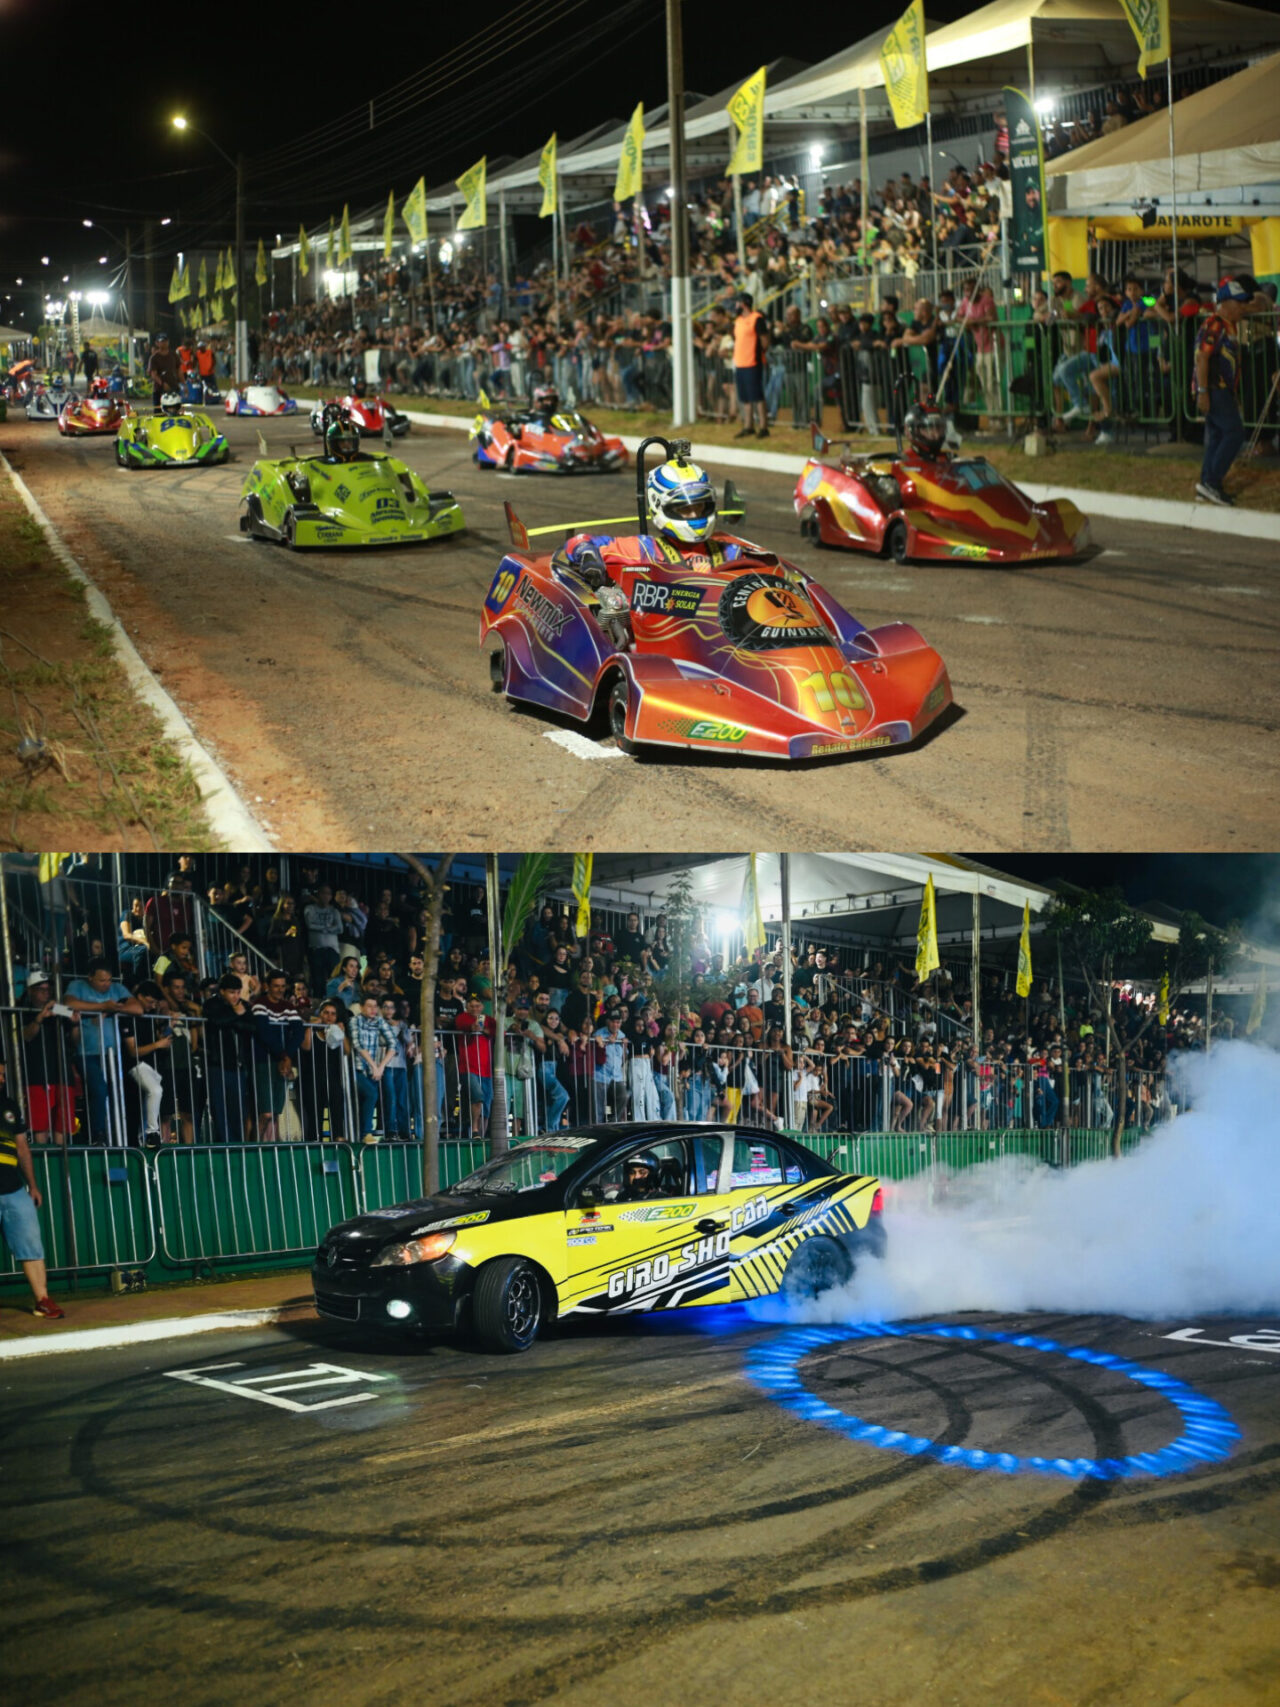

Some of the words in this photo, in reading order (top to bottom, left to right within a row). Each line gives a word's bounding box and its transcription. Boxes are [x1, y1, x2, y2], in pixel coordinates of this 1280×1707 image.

[1155, 215, 1232, 228] AMAROTE
[491, 570, 515, 603] 10
[633, 582, 669, 609] RBR
[671, 589, 700, 599] ENERGIA
[674, 600, 697, 611] SOLAR
[800, 670, 866, 713] 10
[690, 721, 746, 742] E200
[811, 742, 848, 755] Renato
[849, 734, 891, 751] Balestra
[646, 1205, 695, 1220] E200
[730, 1194, 768, 1233] CAR
[608, 1254, 669, 1298] GIRO
